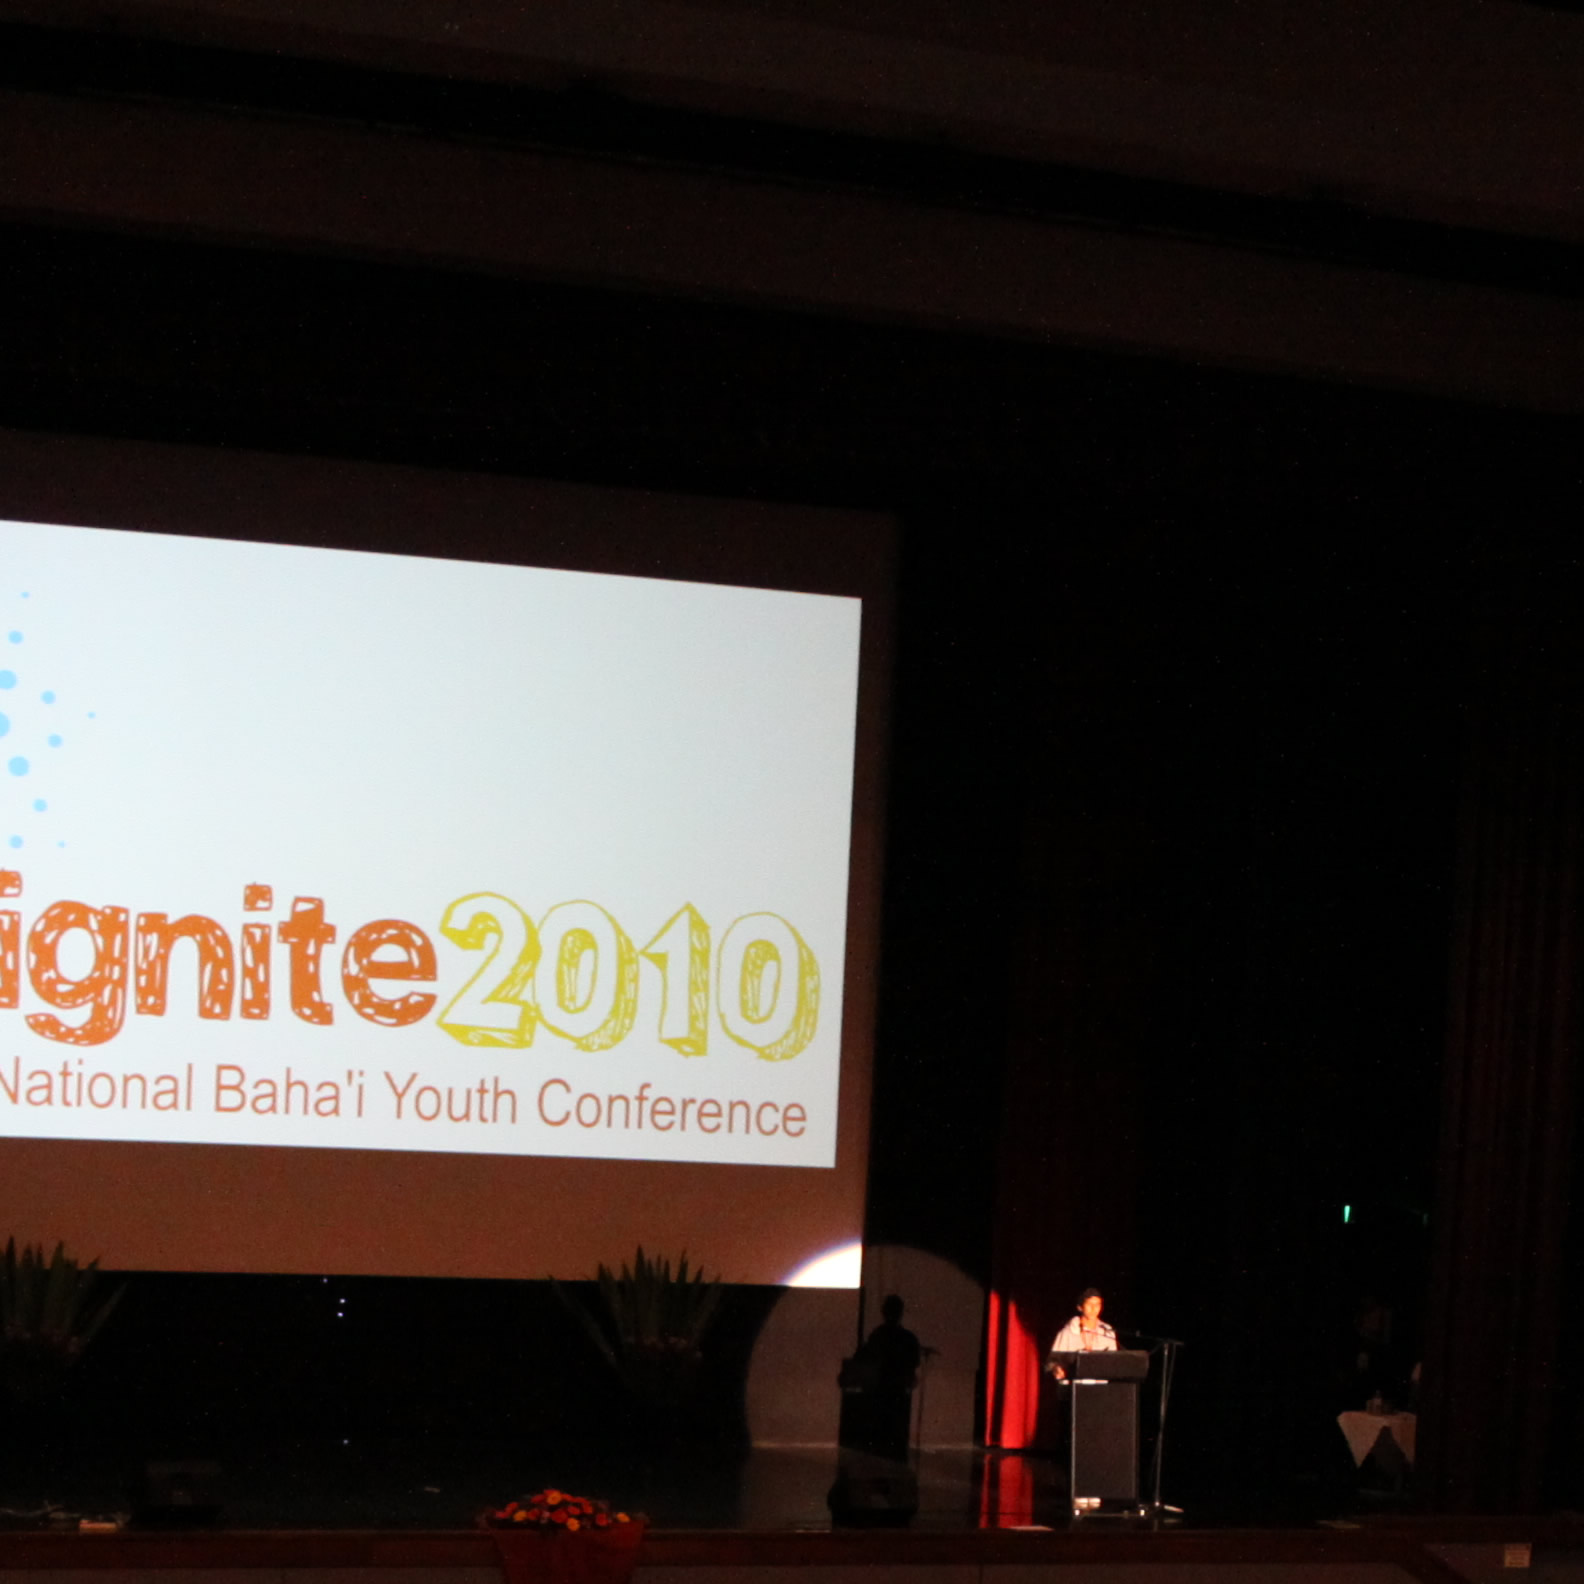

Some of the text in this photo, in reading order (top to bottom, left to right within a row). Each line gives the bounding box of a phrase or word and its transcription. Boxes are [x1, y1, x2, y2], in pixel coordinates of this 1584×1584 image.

[214, 1064, 365, 1118] Baha'i
[384, 1072, 517, 1124] Youth
[537, 1078, 807, 1137] Conference
